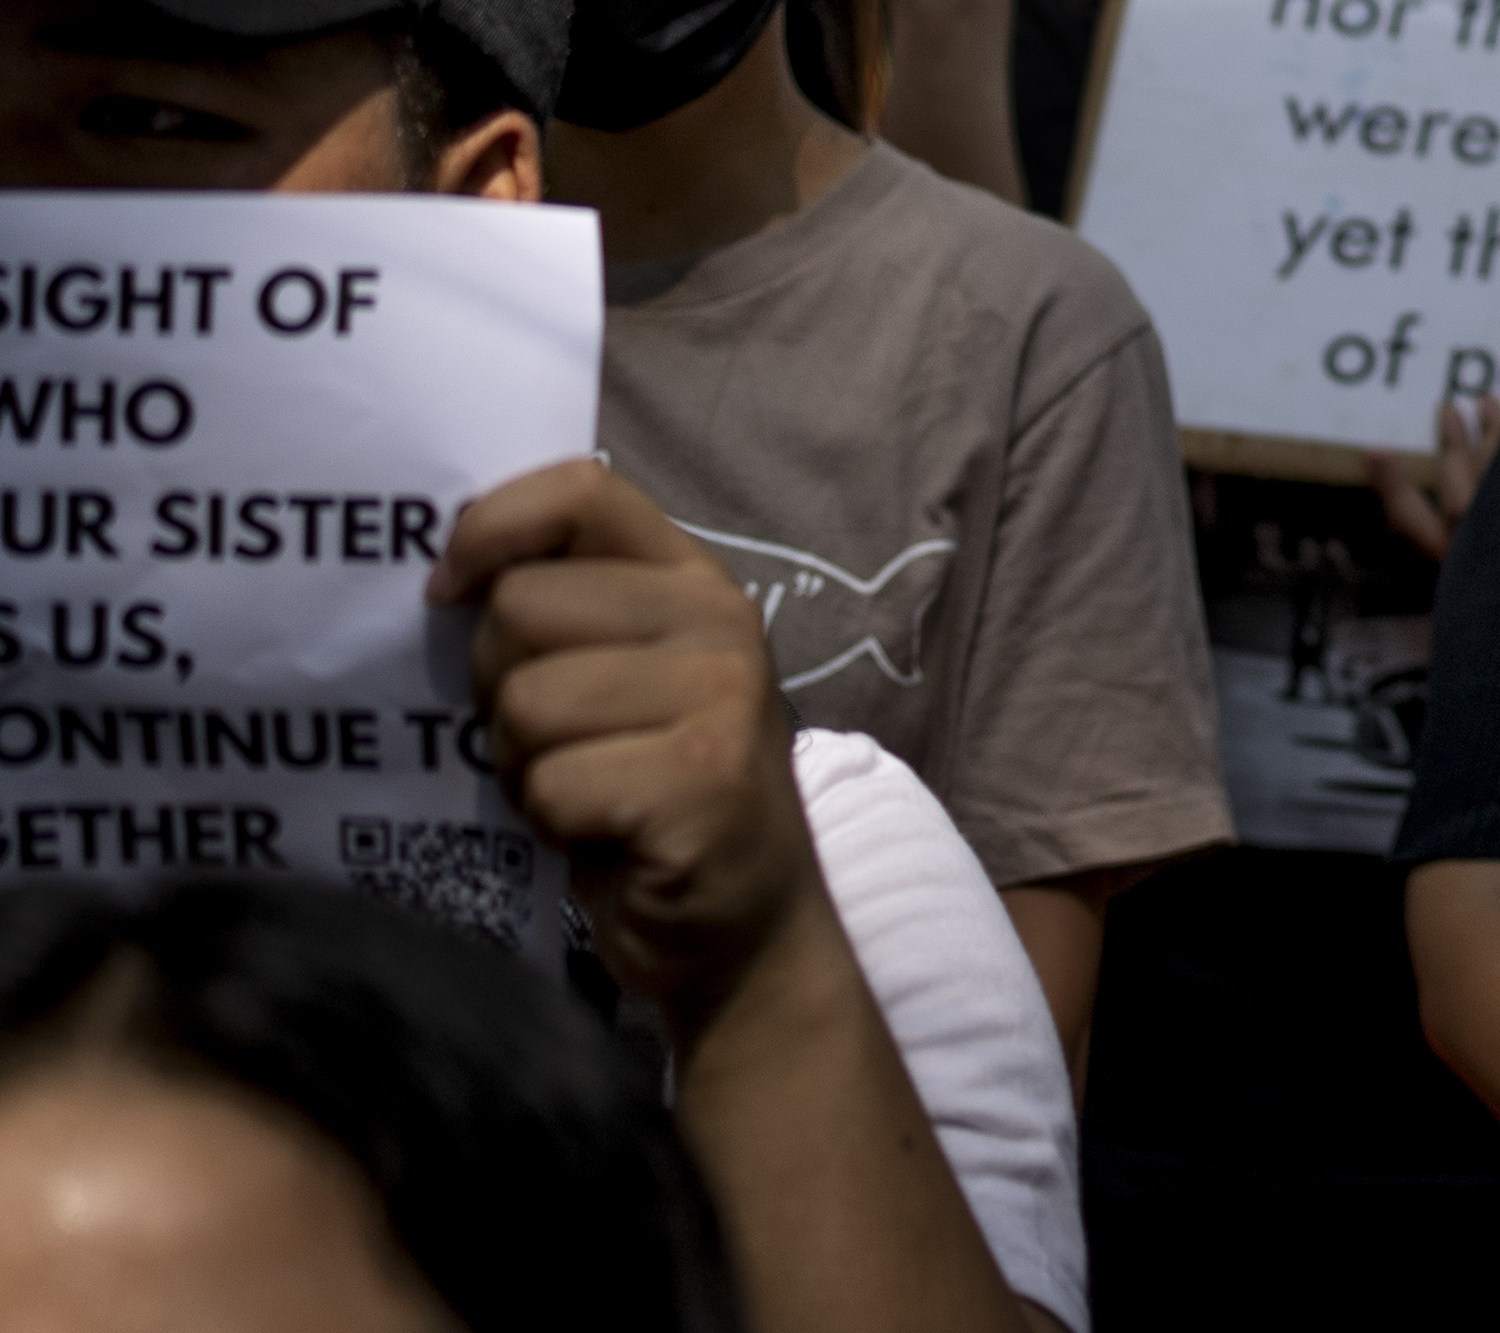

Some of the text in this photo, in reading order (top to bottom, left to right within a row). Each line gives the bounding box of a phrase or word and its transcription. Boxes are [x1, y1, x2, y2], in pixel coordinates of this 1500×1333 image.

[1276, 207, 1416, 282] yet
[0, 262, 379, 339] IGHT OF
[1321, 311, 1421, 389] of
[151, 491, 478, 566] SISTER
[44, 599, 196, 688] US,
